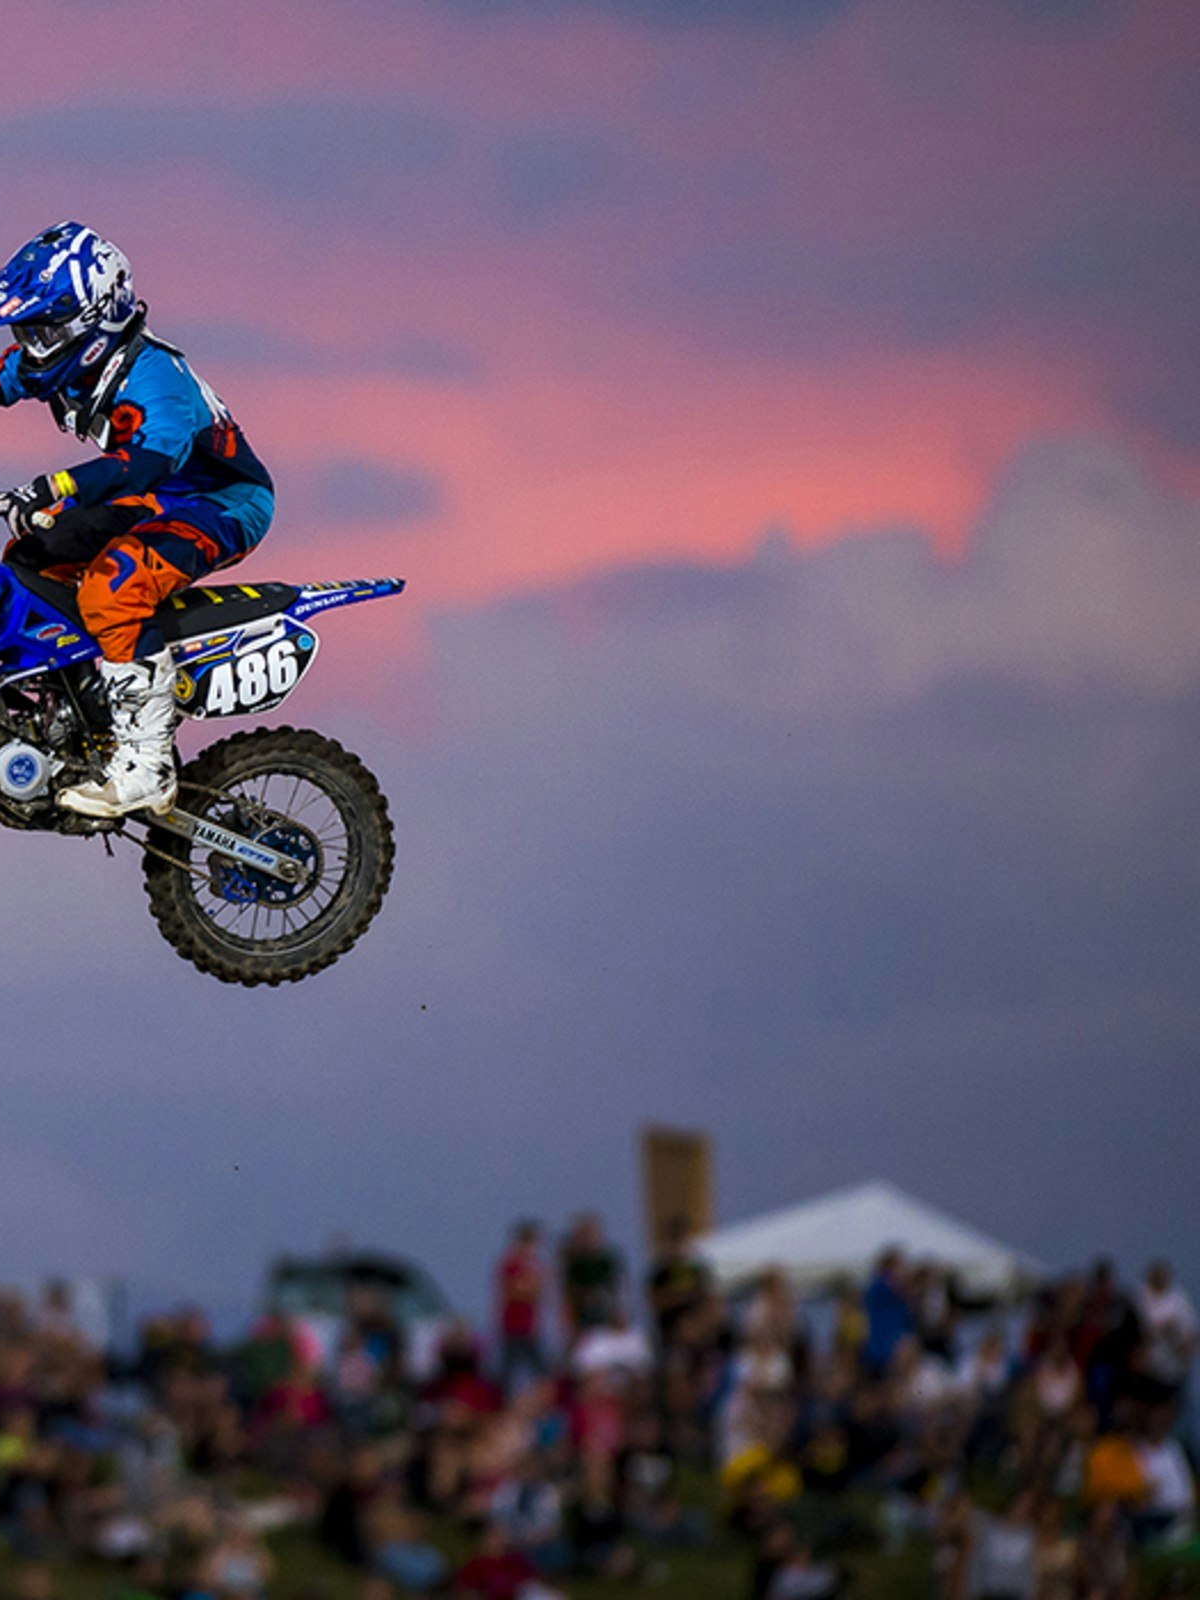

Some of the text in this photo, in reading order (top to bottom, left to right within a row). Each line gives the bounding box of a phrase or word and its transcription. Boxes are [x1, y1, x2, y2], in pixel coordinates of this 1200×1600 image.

[294, 593, 348, 616] DUNLOP
[206, 640, 298, 715] 486
[193, 821, 236, 851] YAMAHA
